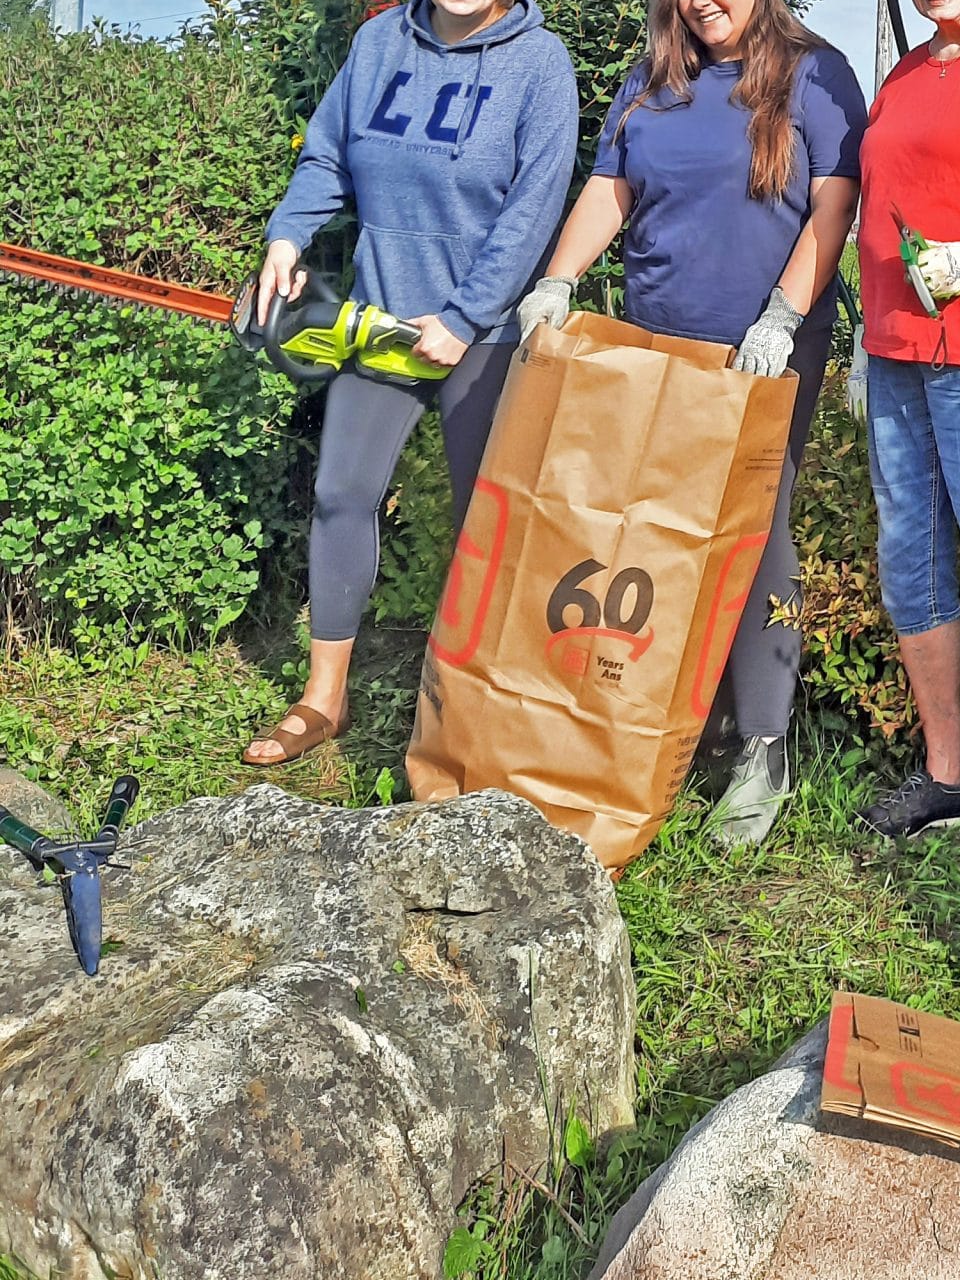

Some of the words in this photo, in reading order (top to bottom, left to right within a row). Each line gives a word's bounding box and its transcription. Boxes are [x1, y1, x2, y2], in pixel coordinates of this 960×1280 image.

[546, 558, 654, 634] 60
[597, 656, 624, 670] Years
[600, 669, 622, 681] Ans
